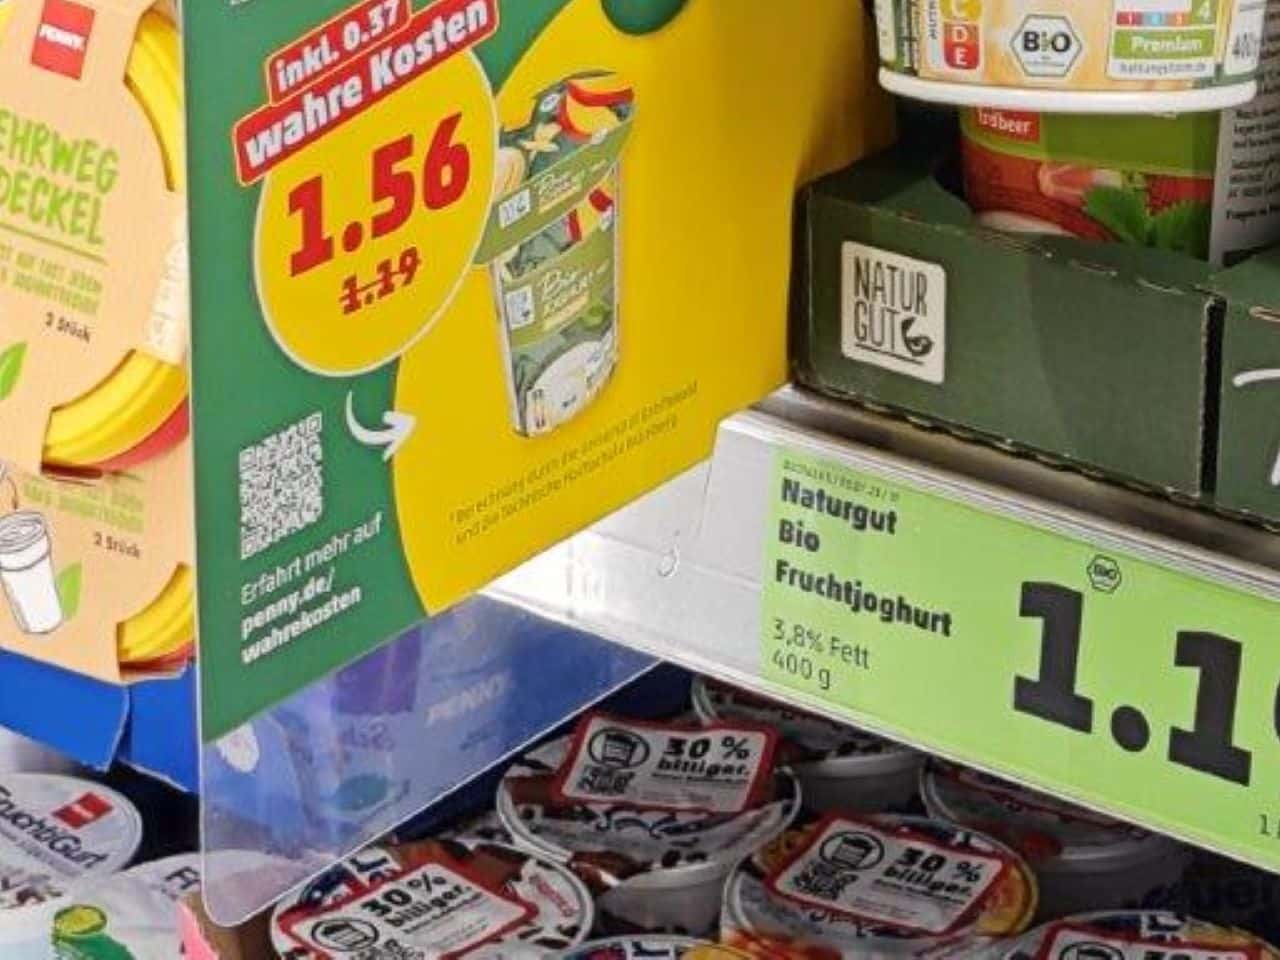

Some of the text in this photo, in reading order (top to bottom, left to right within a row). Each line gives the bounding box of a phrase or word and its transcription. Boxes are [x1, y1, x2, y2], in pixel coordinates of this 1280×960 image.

[953, 26, 968, 42] D
[955, 48, 967, 67] E
[274, 39, 340, 91] inkl.
[246, 75, 362, 169] wahre
[0, 109, 119, 195] EHRWEG
[288, 112, 470, 277] 1.56
[340, 246, 422, 314] 1.19
[854, 256, 928, 317] NATUR
[853, 299, 901, 353] GUT
[782, 478, 897, 535] Naturgut
[241, 511, 382, 605] Erfahrt mehr auf
[778, 518, 820, 553] Bio
[241, 586, 361, 664] wahrekosten
[242, 566, 336, 640] penny.de/
[775, 559, 952, 637] Fruchtjoghurt
[772, 649, 831, 690] 400 g
[773, 618, 870, 670] 3,8% Fett
[663, 736, 750, 760] 30 %
[1259, 814, 1270, 837] 1
[408, 872, 447, 893] %
[899, 847, 983, 883] 30 %
